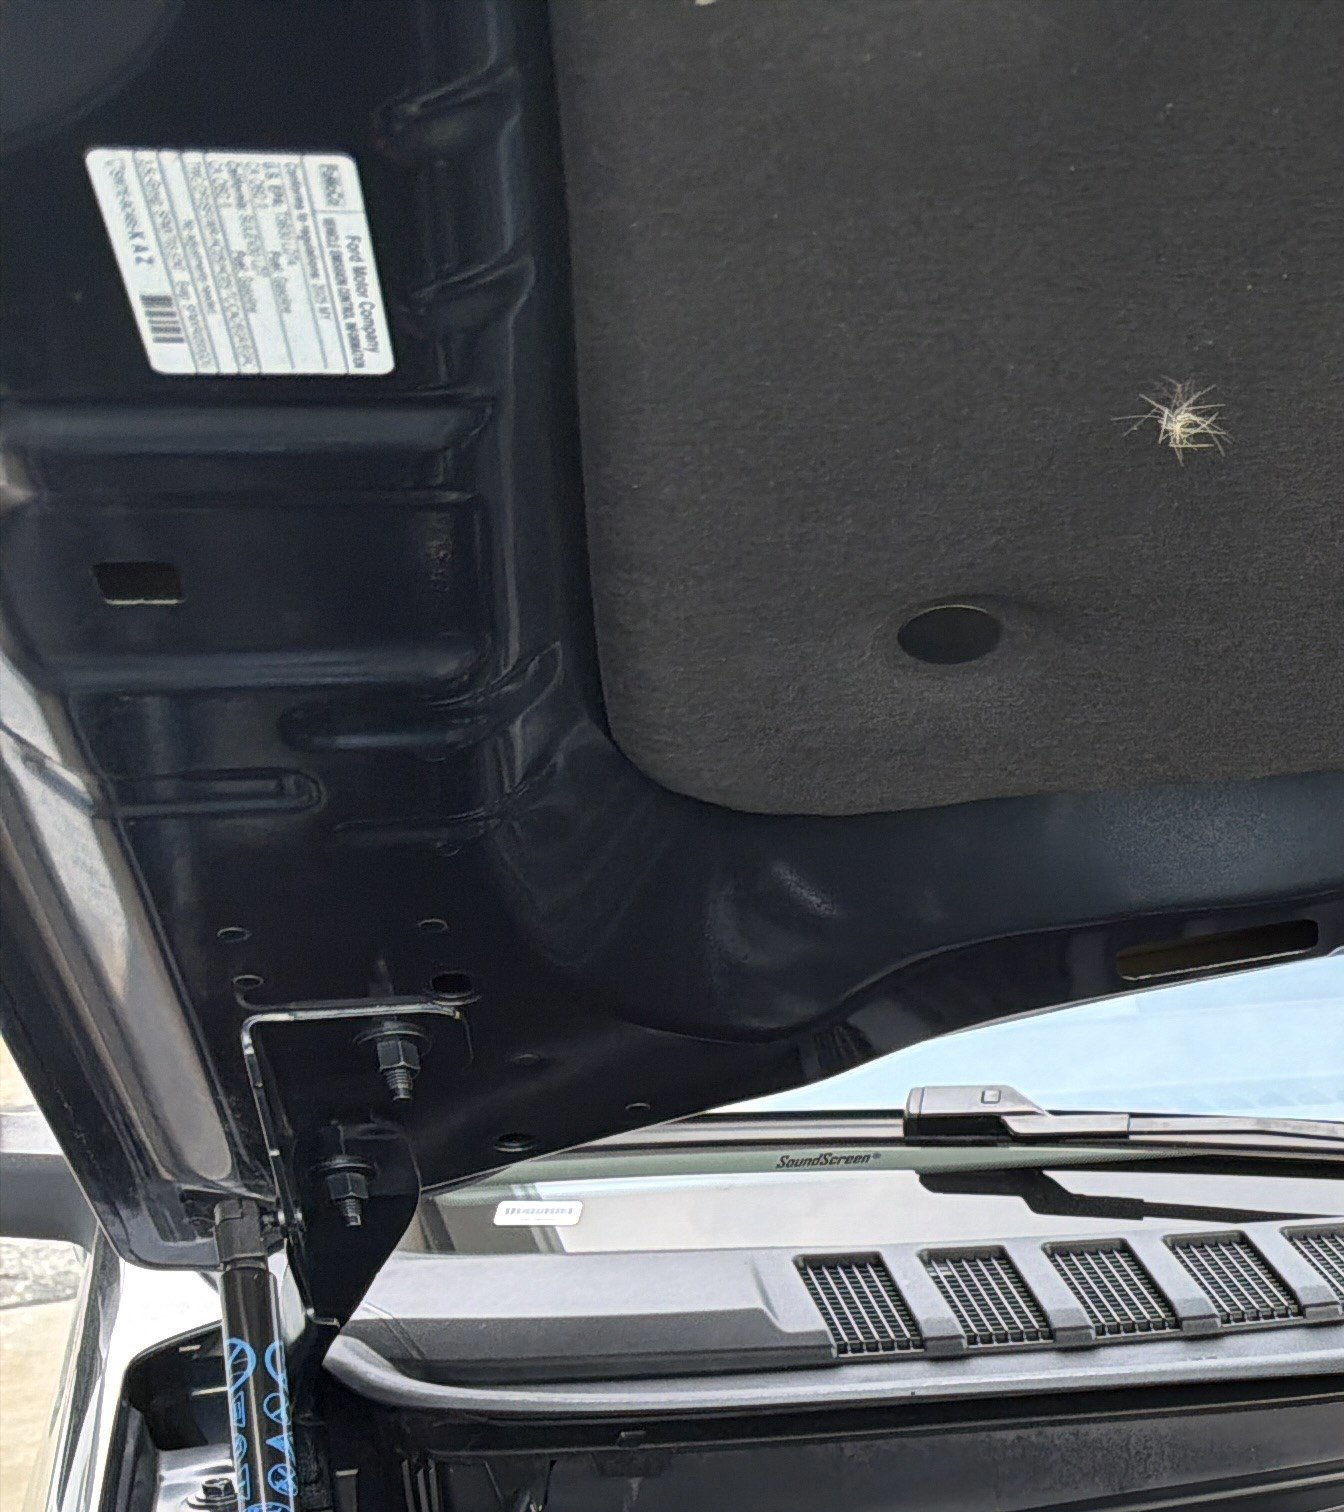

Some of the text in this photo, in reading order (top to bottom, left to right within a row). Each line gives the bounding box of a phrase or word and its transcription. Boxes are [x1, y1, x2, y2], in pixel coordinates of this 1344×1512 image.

[345, 235, 380, 353] Ford Motor Company
